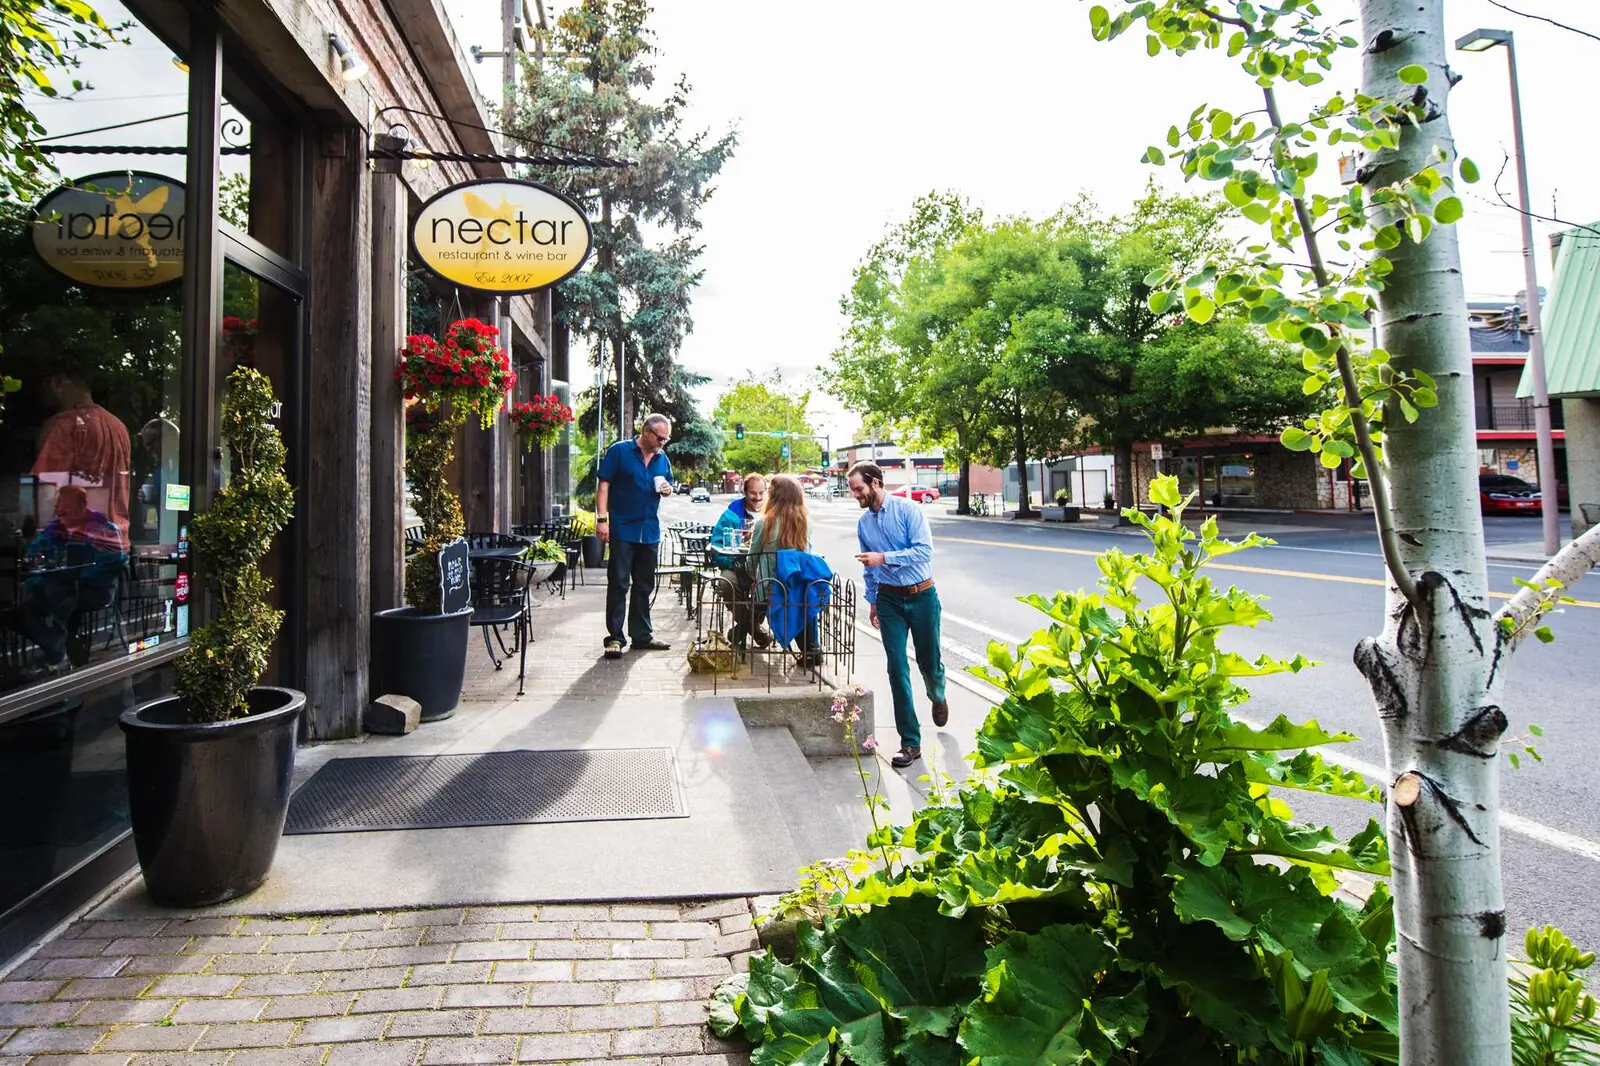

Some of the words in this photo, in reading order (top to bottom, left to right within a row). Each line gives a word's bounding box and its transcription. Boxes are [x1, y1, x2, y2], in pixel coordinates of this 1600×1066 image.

[431, 211, 573, 246] nectar
[438, 249, 500, 261] restaurant
[504, 250, 513, 261] &
[516, 250, 544, 261] wine
[547, 250, 568, 262] bar
[474, 272, 496, 285] Est.
[500, 272, 533, 285] 2007
